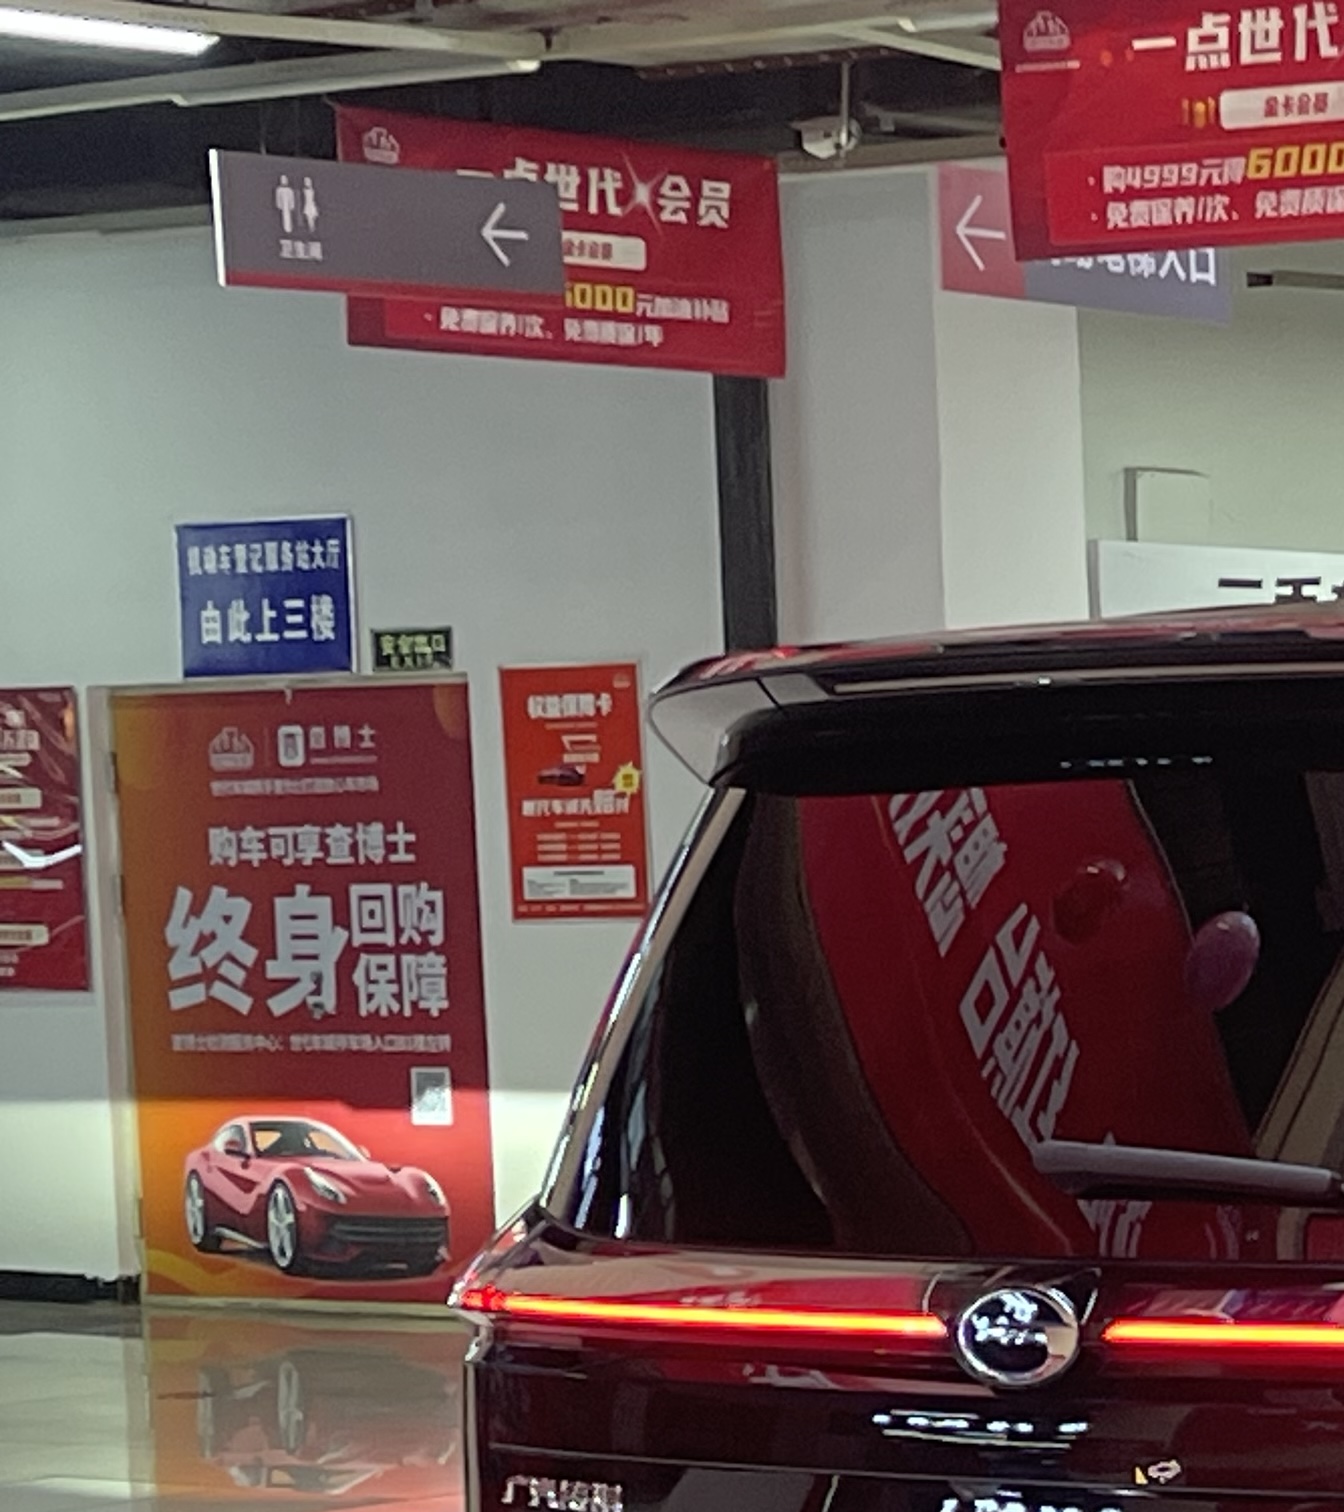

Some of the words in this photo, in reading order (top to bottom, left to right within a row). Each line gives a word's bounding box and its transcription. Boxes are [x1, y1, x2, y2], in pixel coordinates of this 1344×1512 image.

[208, 820, 416, 868] 购车可享查博士
[350, 881, 444, 948] 回购
[165, 884, 349, 1020] 终身
[352, 951, 450, 1018] 保障
